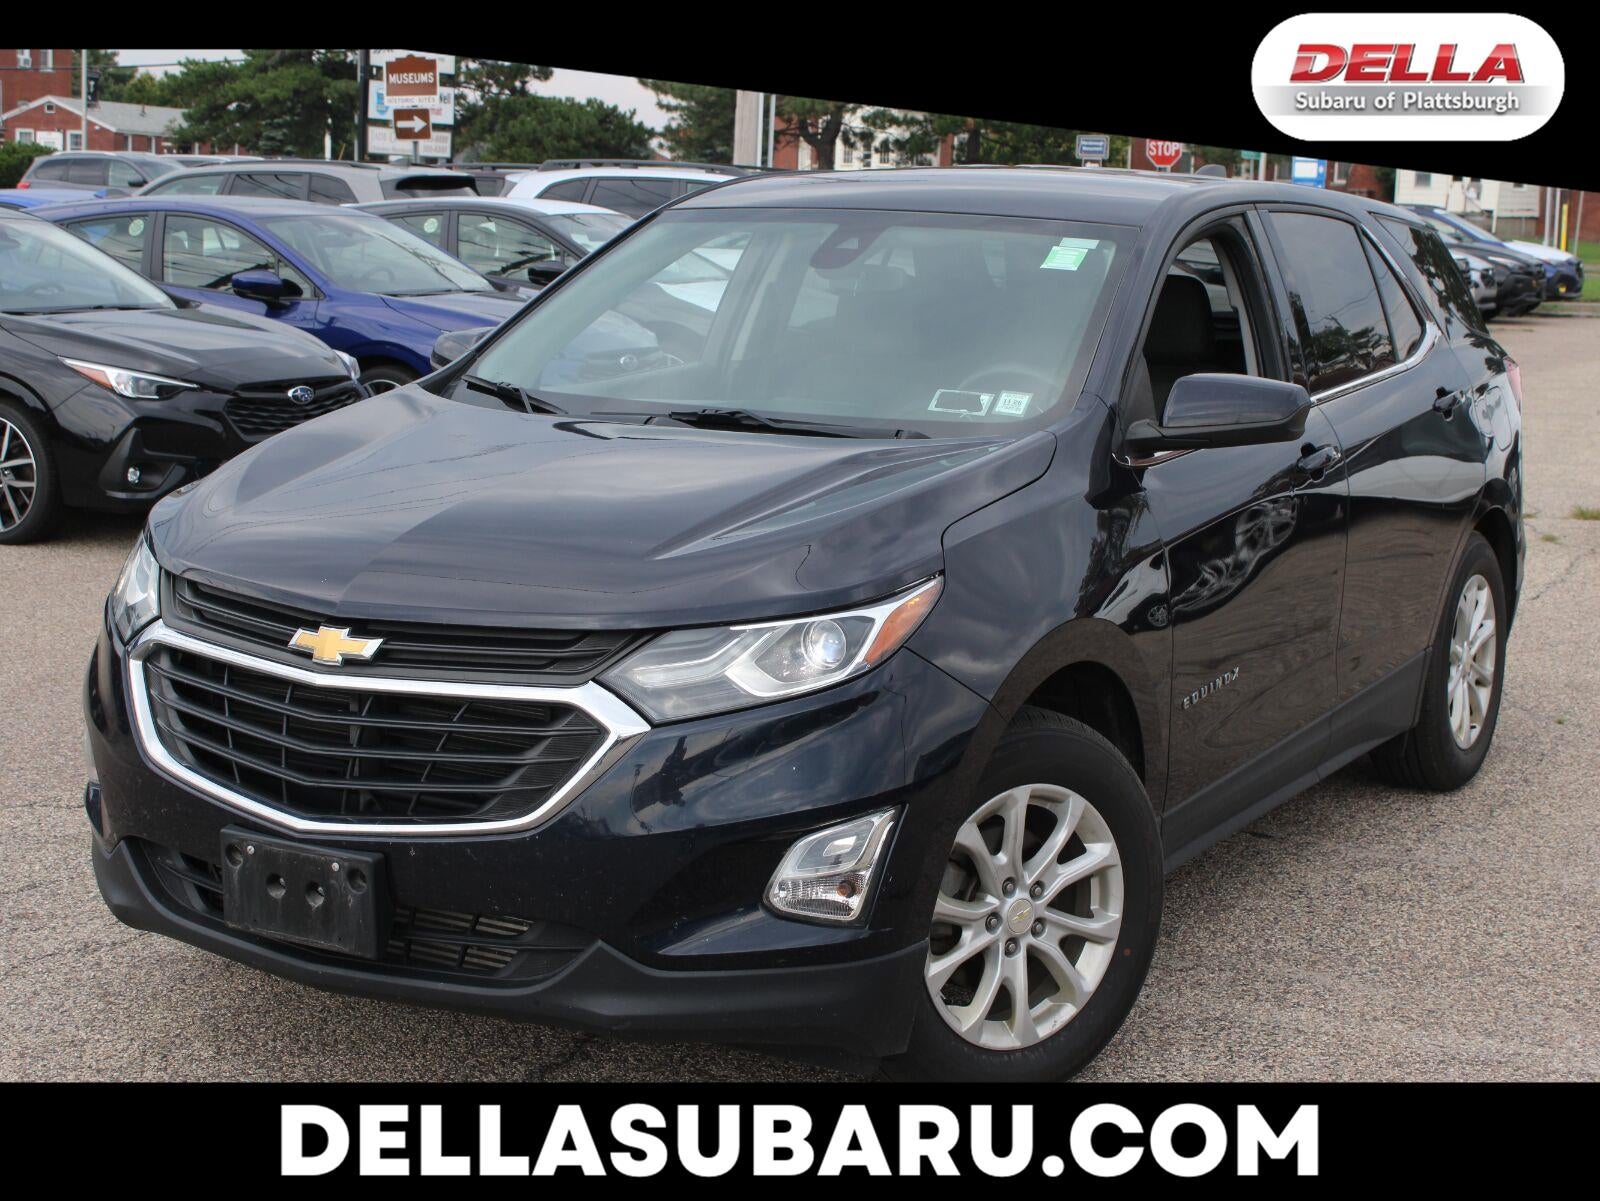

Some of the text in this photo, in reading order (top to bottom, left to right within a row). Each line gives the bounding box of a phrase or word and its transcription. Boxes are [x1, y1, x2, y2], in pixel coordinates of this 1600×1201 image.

[389, 73, 434, 84] MUSEUMS
[1149, 141, 1179, 157] STOP
[1183, 667, 1239, 709] EQUINOX
